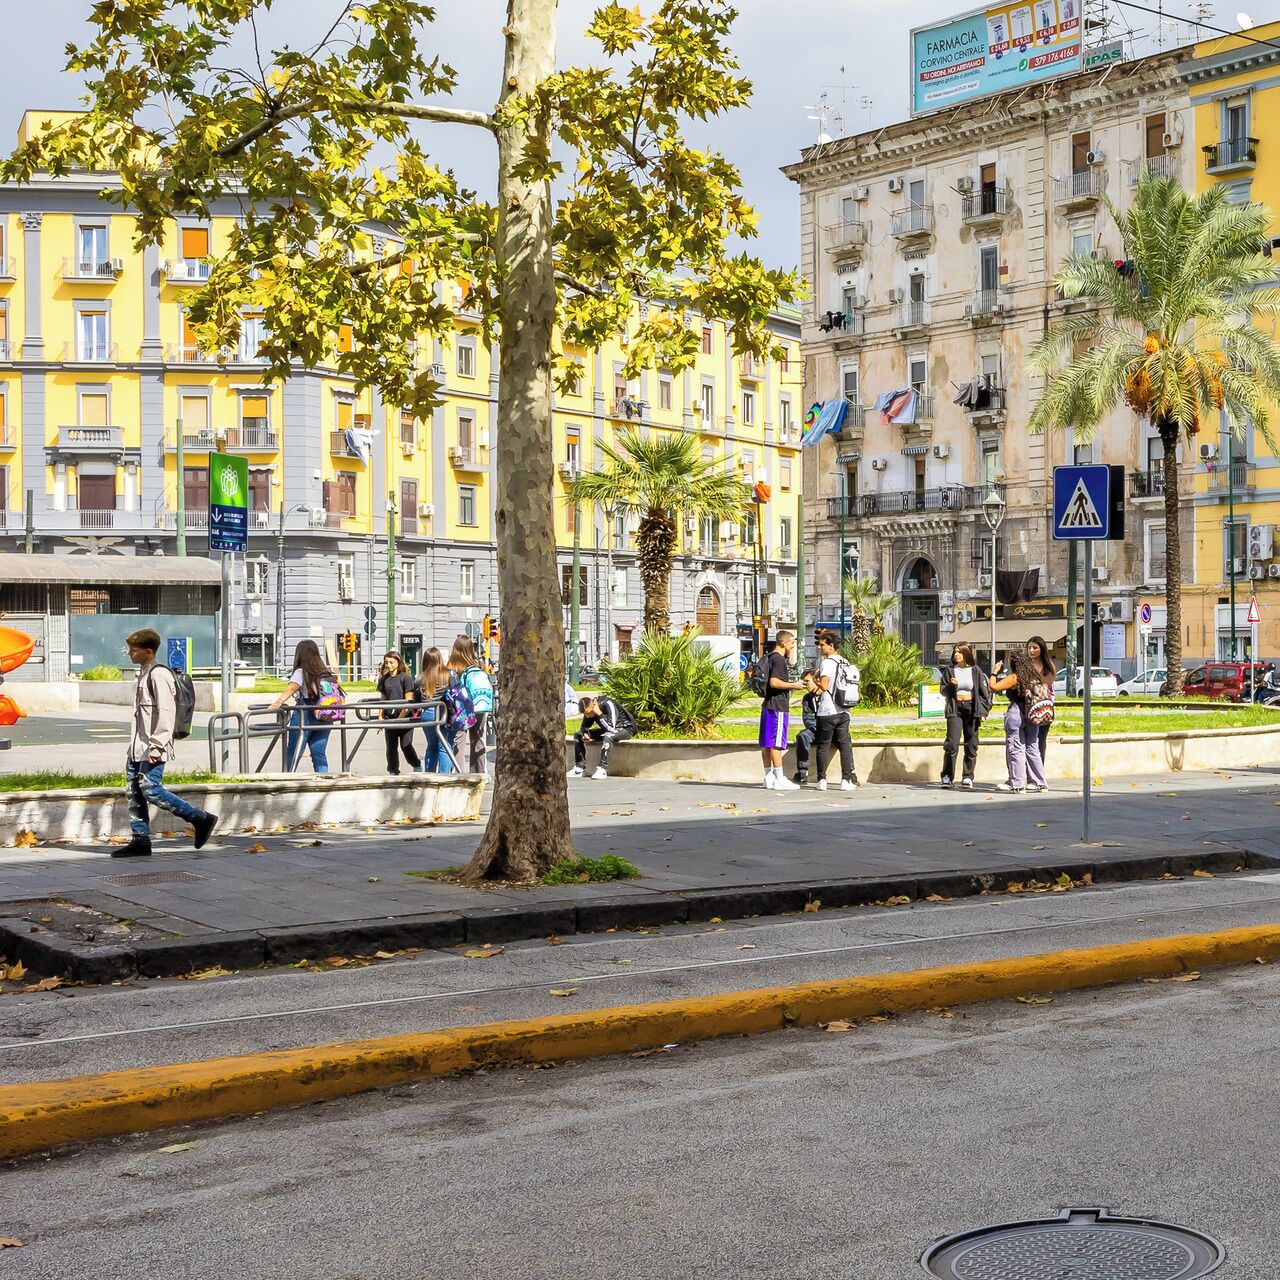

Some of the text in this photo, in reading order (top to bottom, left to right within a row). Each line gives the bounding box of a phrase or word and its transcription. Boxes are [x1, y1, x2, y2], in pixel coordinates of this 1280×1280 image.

[927, 31, 978, 55] FARMACIA
[920, 44, 985, 69] CORVINO CENTRALE
[1034, 56, 1046, 66] 379
[1048, 52, 1058, 63] 176
[1059, 48, 1074, 60] 4166
